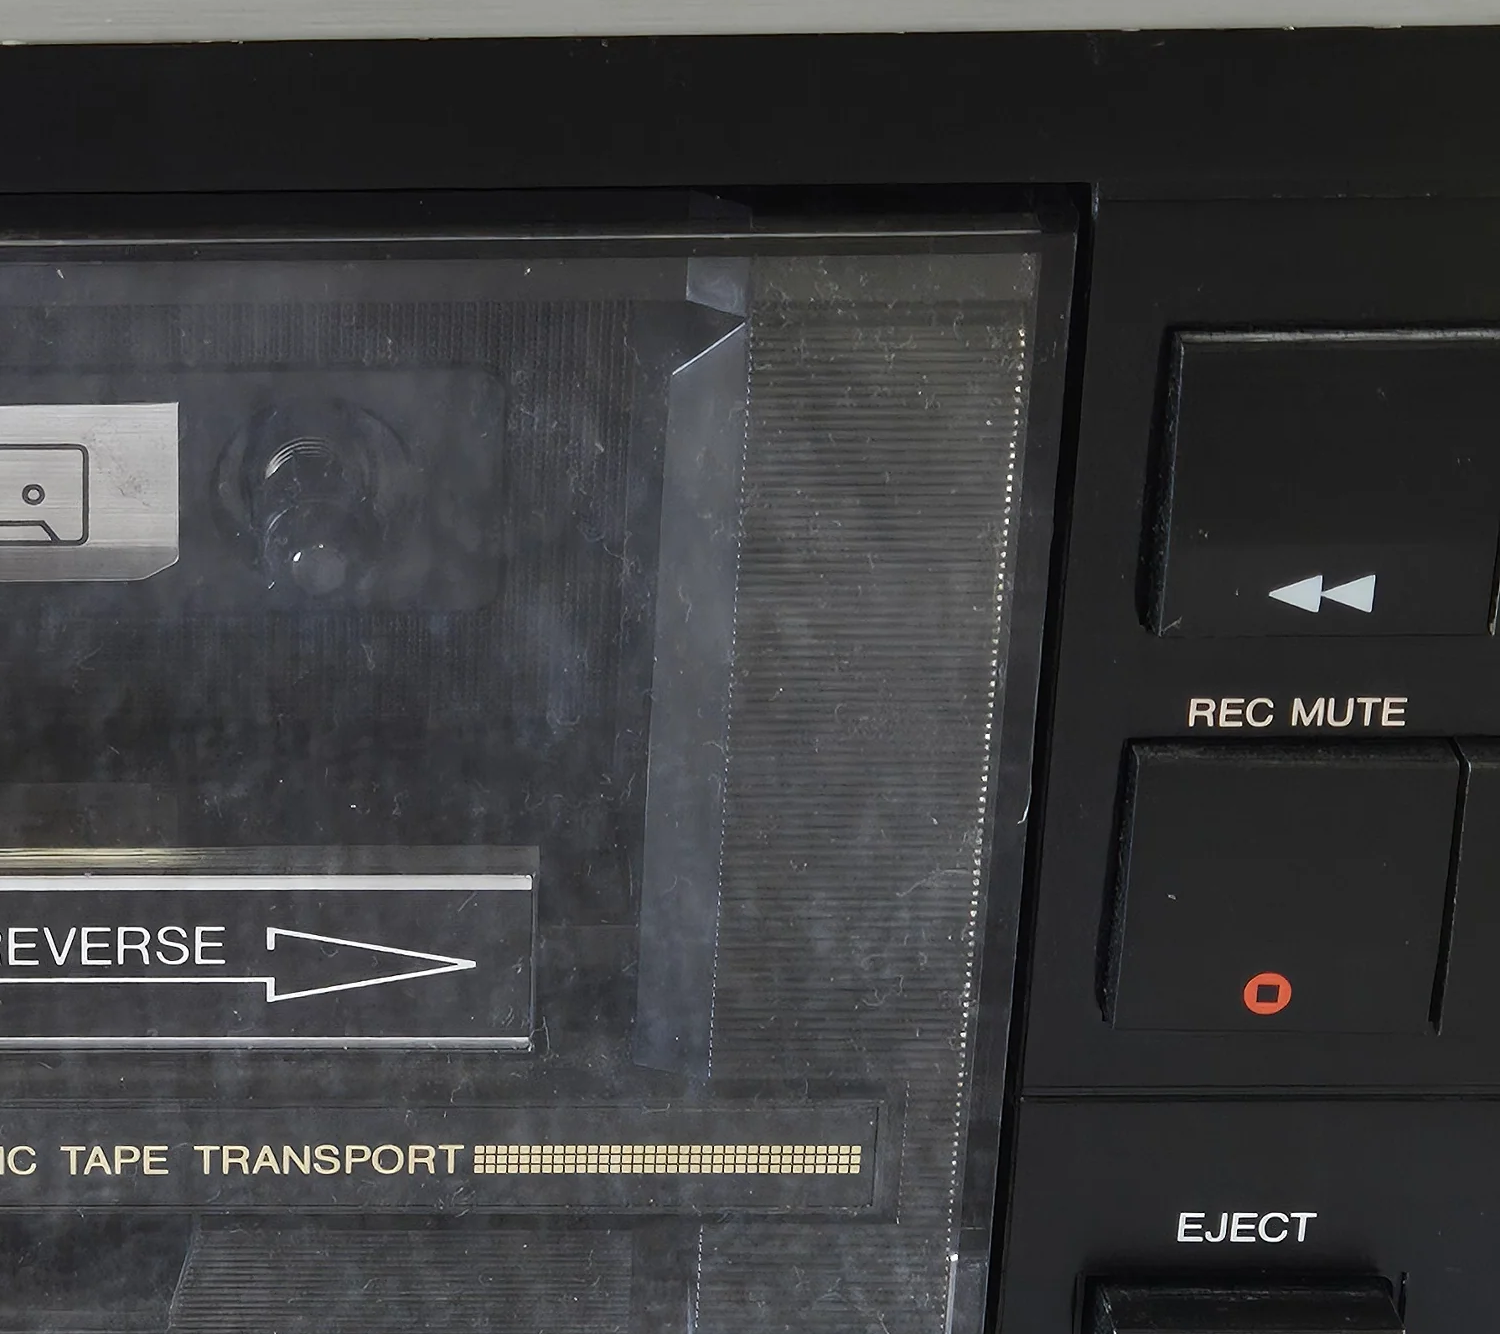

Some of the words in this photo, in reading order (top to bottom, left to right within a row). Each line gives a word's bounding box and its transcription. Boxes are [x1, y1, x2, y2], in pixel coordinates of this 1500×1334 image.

[1187, 696, 1274, 728] REC
[1291, 696, 1408, 727] MUTE
[59, 1145, 169, 1176] TAPE
[193, 1144, 465, 1175] TRANSPORT
[1176, 1212, 1318, 1244] EJECT
